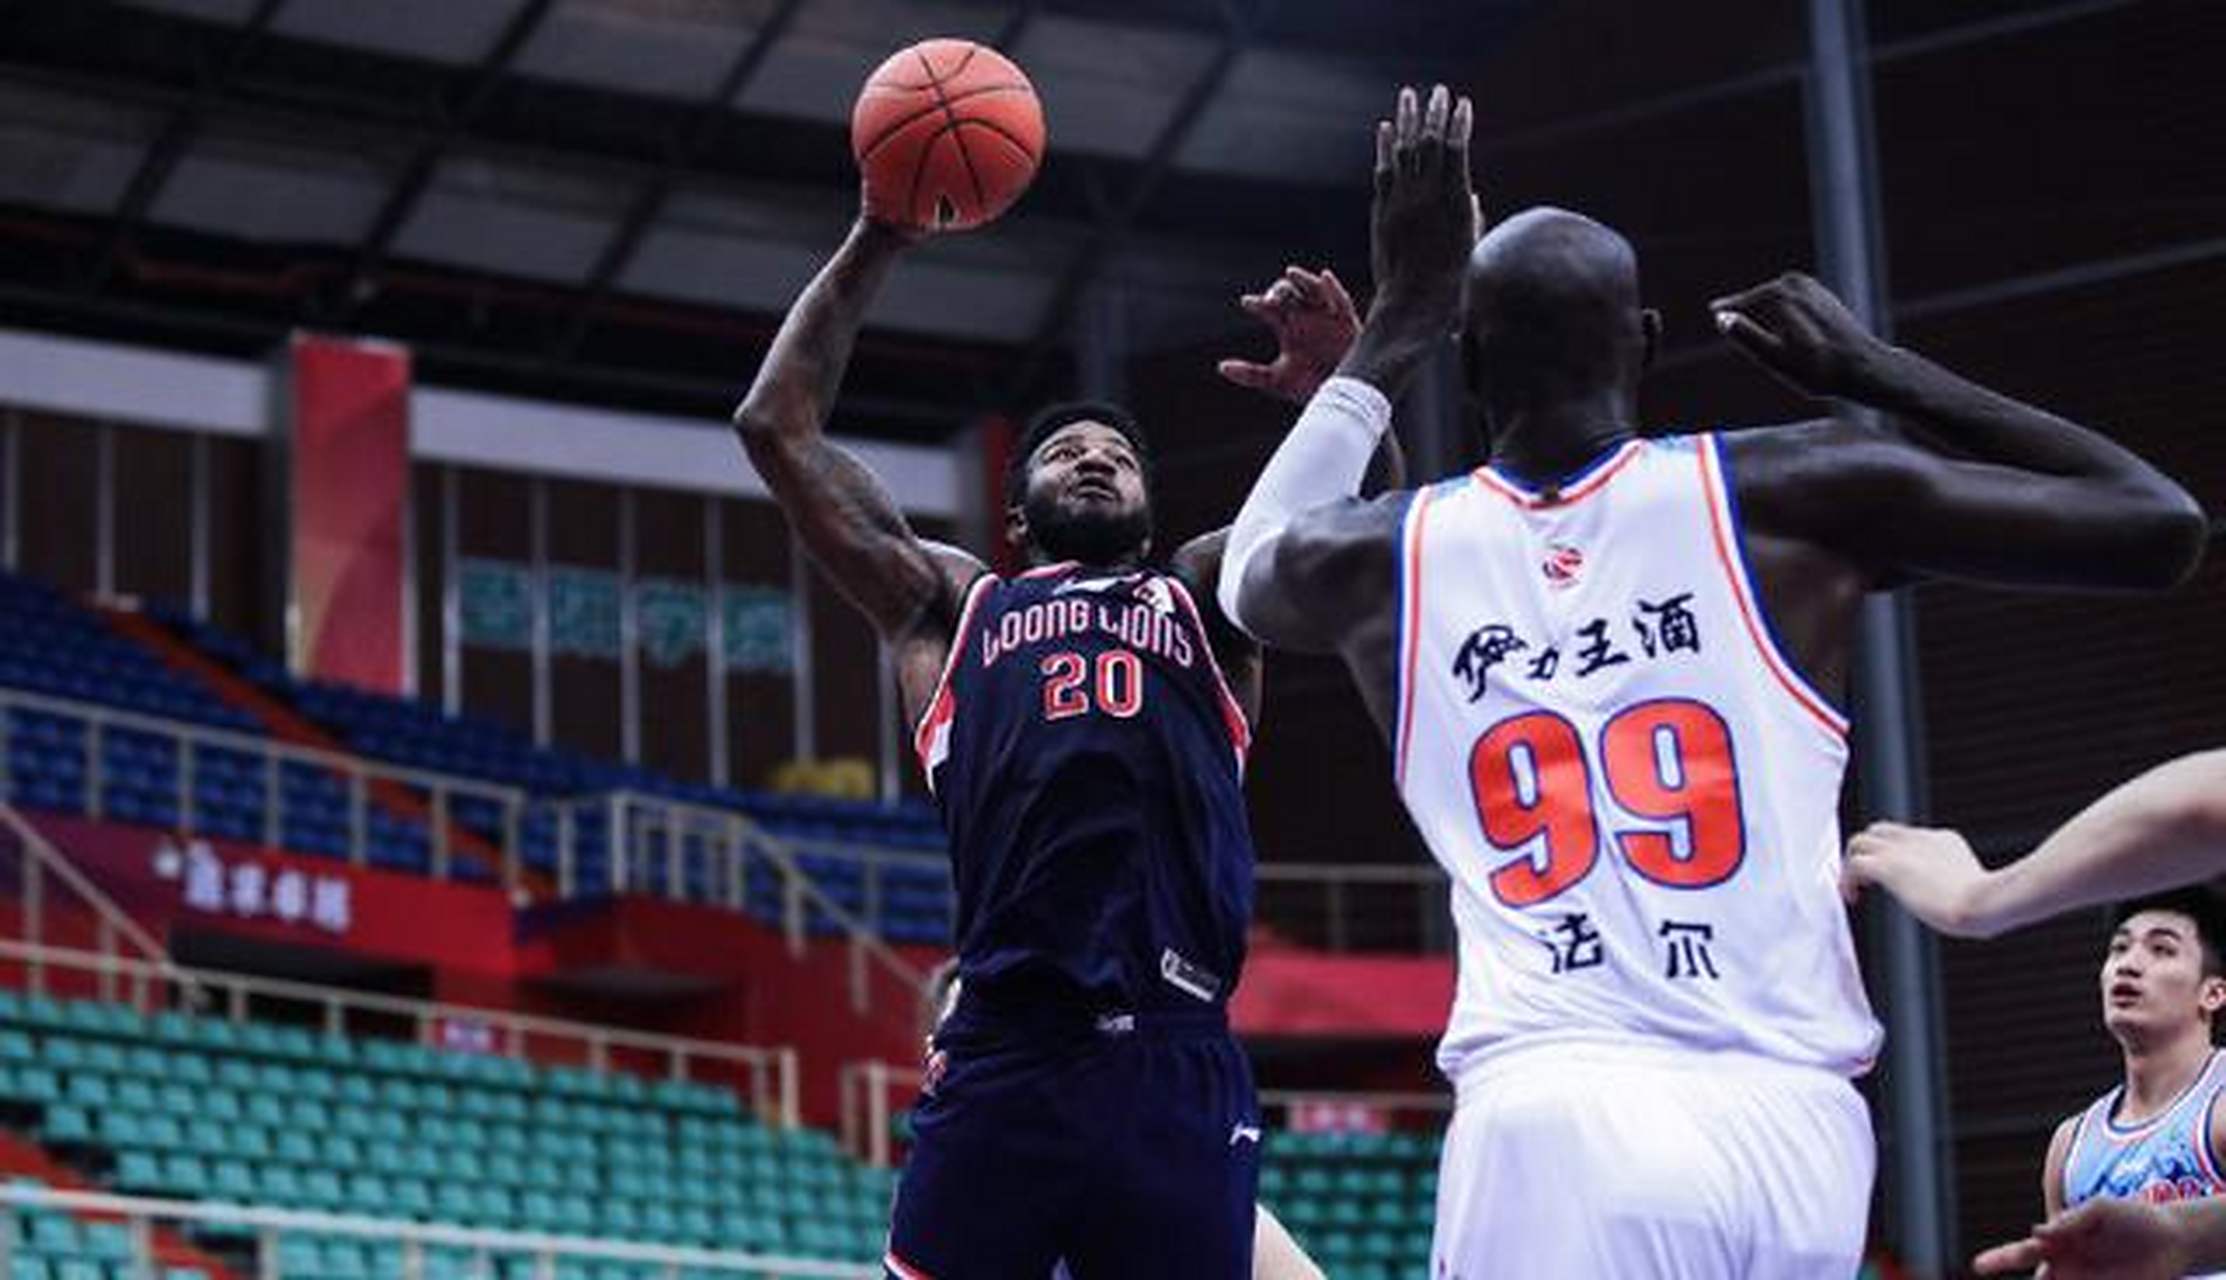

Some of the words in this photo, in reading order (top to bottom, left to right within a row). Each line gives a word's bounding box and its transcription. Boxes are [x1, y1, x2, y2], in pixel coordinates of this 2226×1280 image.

[981, 598, 1090, 669] LOONG
[1099, 598, 1194, 668] LIONS
[1453, 592, 1700, 703] 伊力王酒
[1040, 649, 1143, 721] 20
[1468, 696, 1746, 909] 99
[1540, 912, 1720, 980] 法尔
